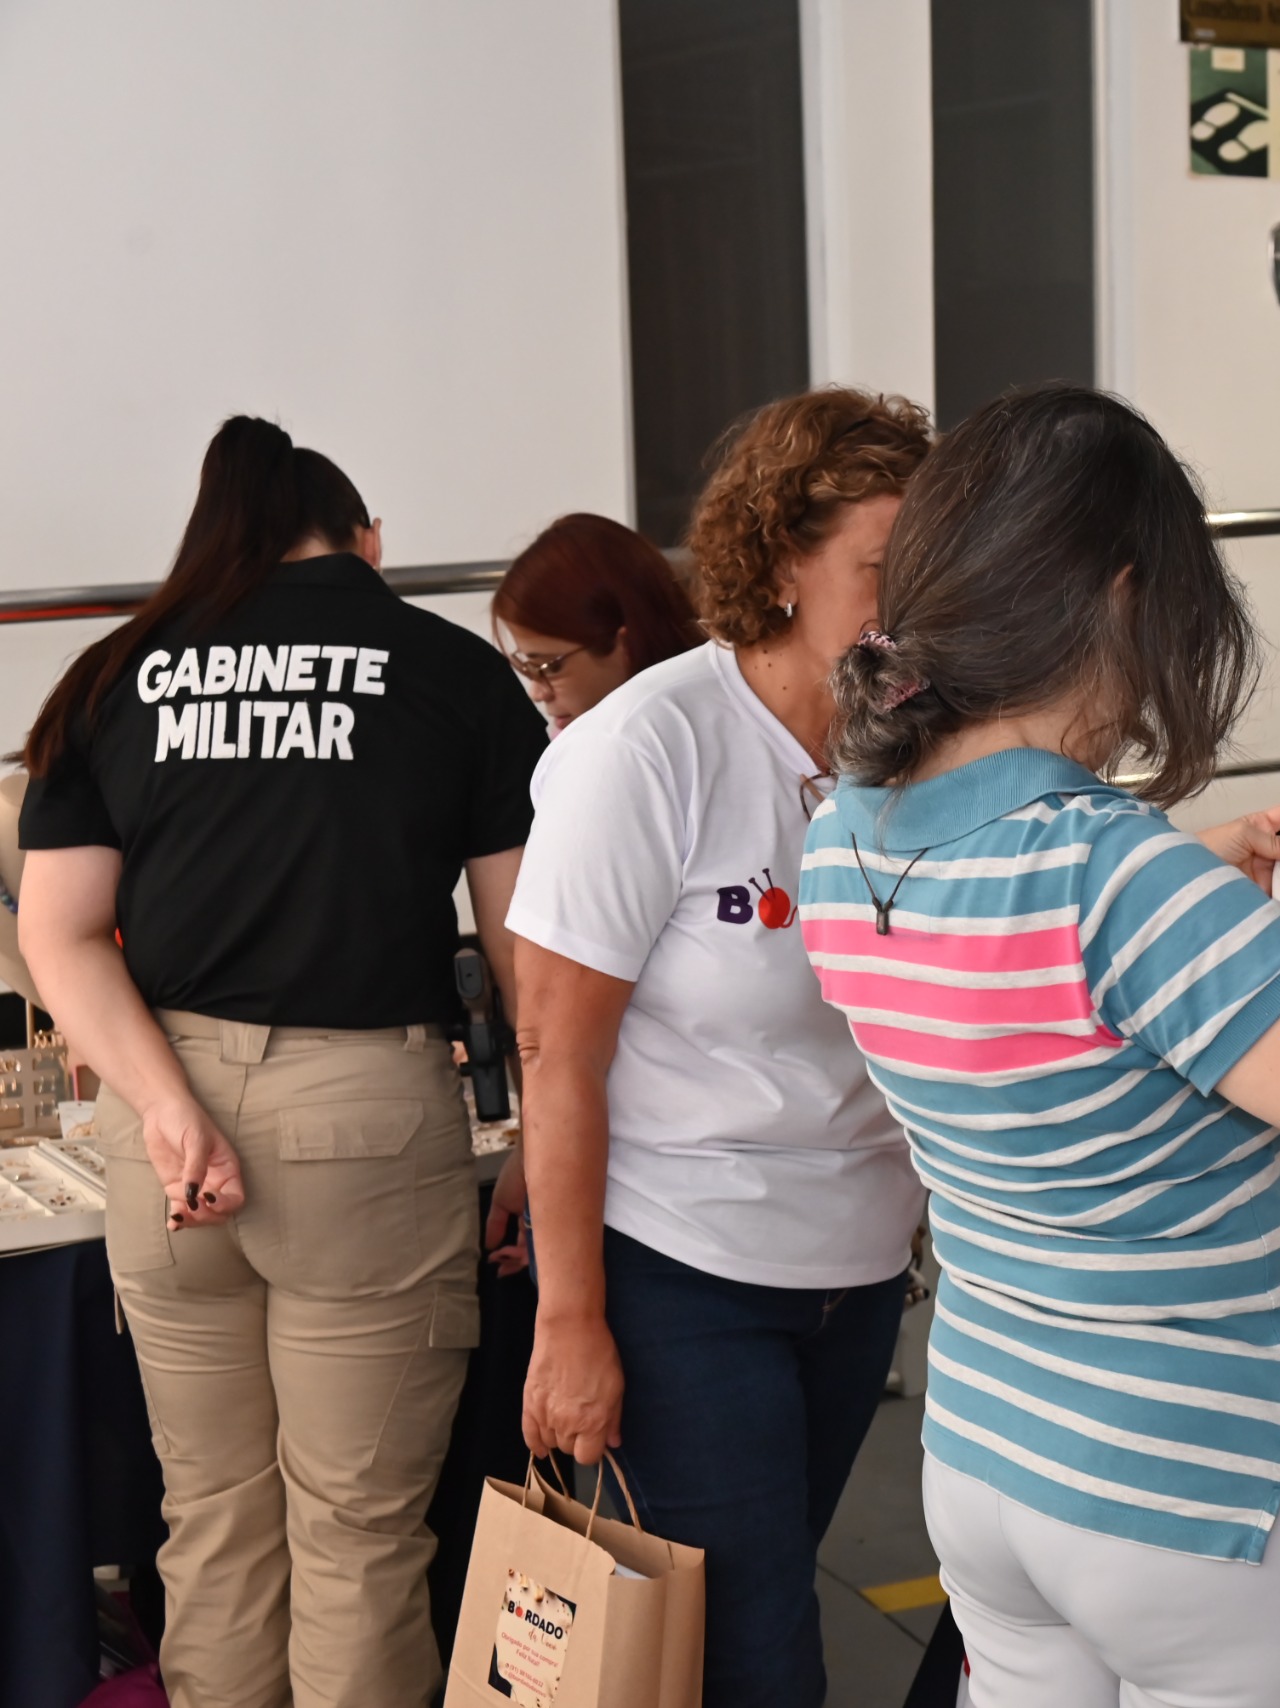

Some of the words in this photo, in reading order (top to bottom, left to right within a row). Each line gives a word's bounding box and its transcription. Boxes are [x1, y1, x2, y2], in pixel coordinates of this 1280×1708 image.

[137, 644, 390, 704] GABINETE
[154, 699, 356, 762] MILITAR
[501, 1632, 522, 1649] Obrigado
[522, 1642, 531, 1653] por
[508, 1600, 563, 1639] BORDADO
